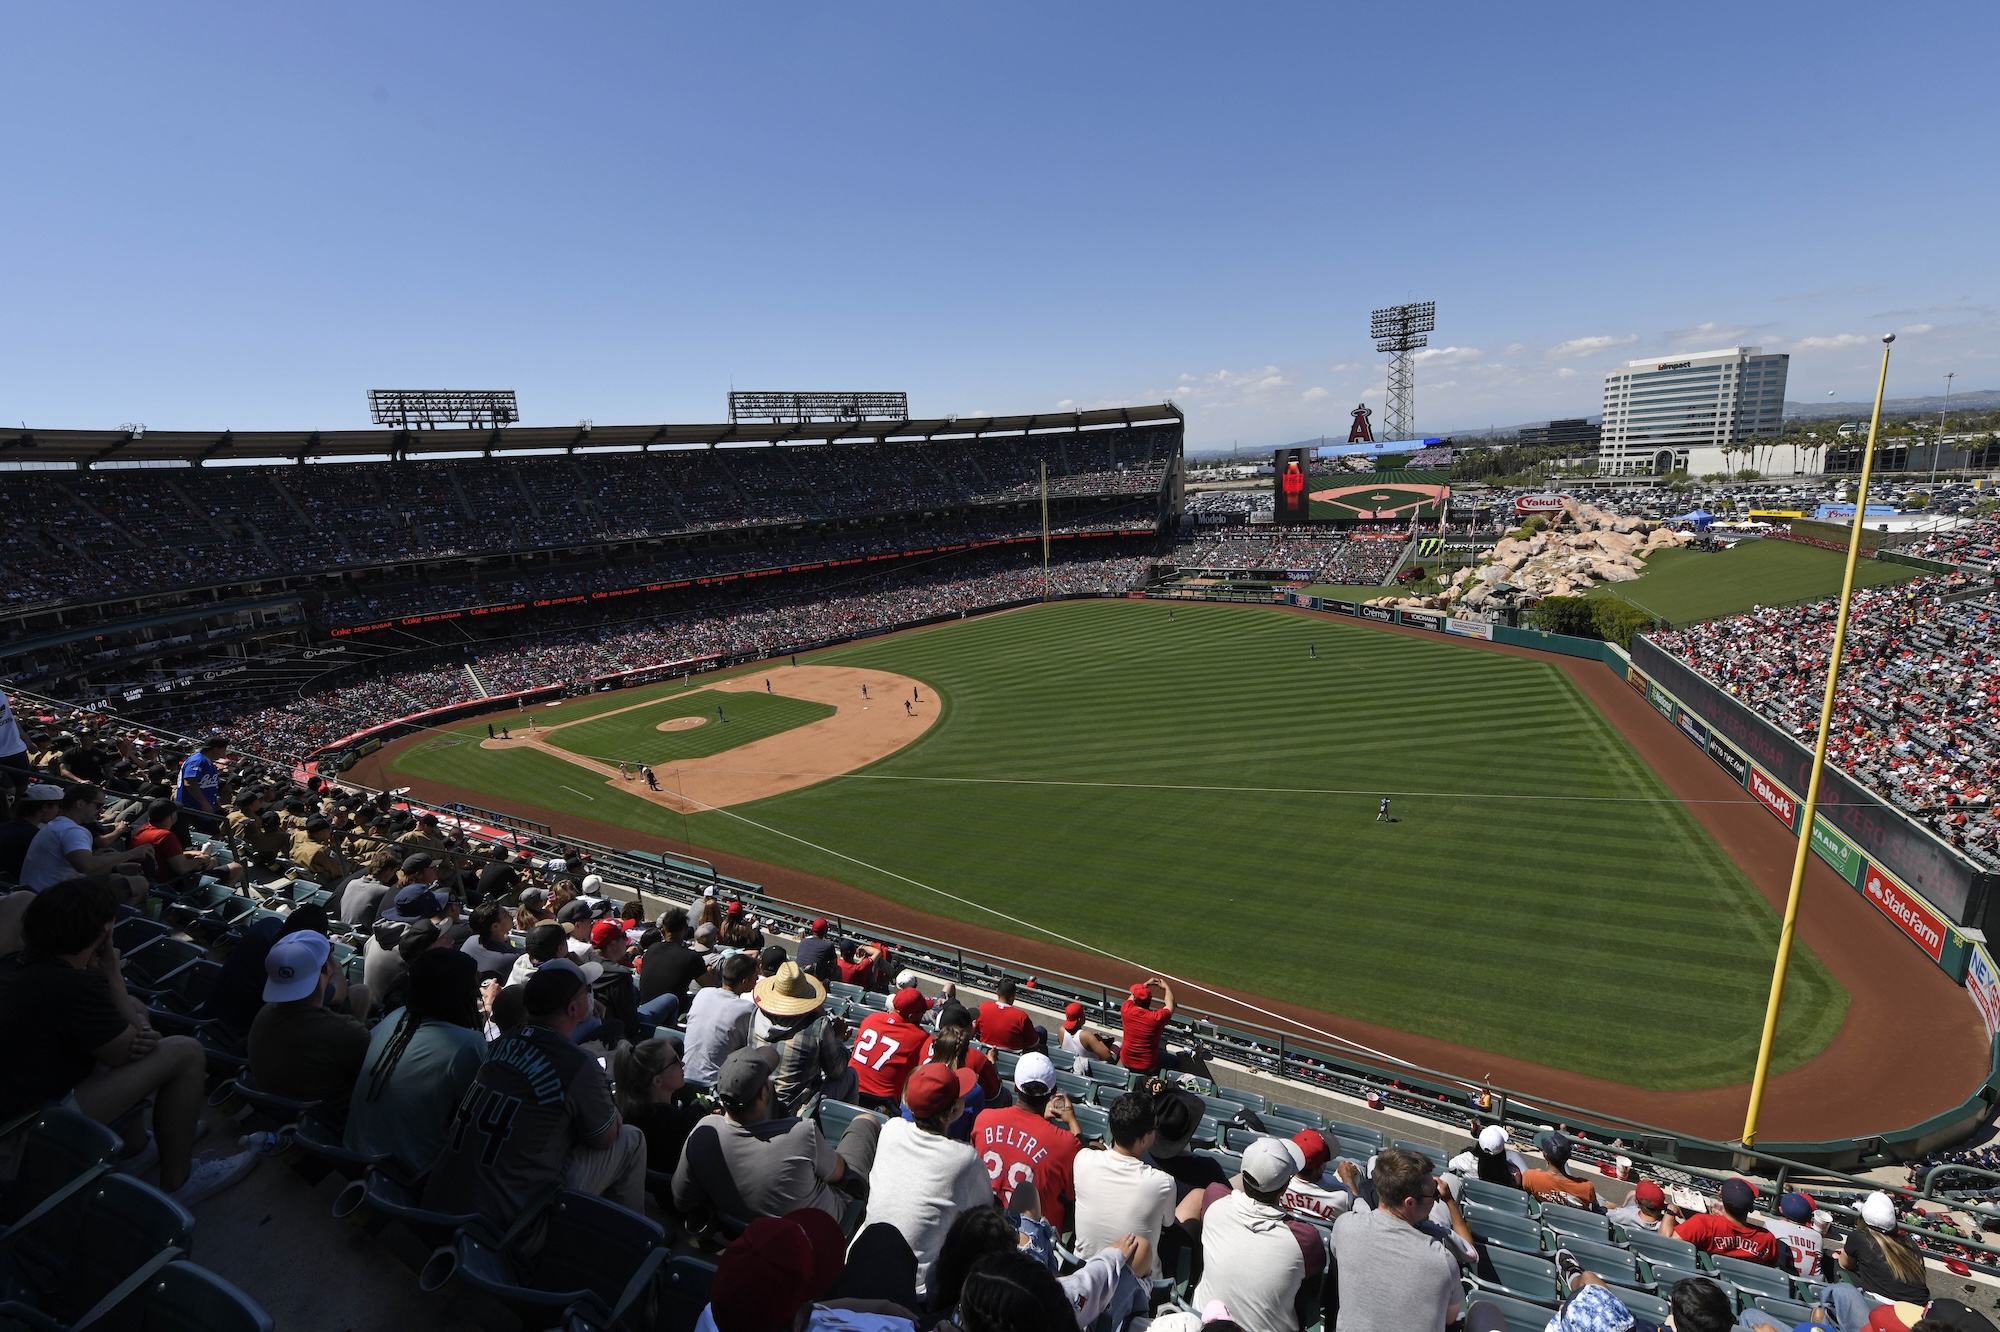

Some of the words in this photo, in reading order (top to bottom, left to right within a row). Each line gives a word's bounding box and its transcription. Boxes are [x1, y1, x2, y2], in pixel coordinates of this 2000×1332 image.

[1525, 499, 1563, 507] Yakult
[1199, 514, 1227, 524] Modelo
[371, 622, 392, 630] SUGAR
[1411, 614, 1437, 623] YOKOHAMA
[314, 645, 346, 656] LEXUS
[215, 665, 247, 677] LEXUS
[1723, 712, 1747, 740] ZERO
[1748, 731, 1784, 767] SUGAR
[1710, 740, 1724, 757] NITTO
[1723, 751, 1745, 777] TIRE.COM
[1753, 773, 1792, 819] Yakult
[1799, 761, 1840, 814] Cke
[1844, 805, 1886, 848] ZERO
[1812, 826, 1824, 842] VA
[1822, 836, 1839, 855] AIR
[1882, 888, 1940, 949] StateFarm
[1953, 934, 1964, 949] 365
[1970, 951, 2000, 1030] NEXGE
[853, 1028, 901, 1071] 27
[452, 1079, 523, 1169] 44
[985, 1125, 1048, 1164] BELTRE
[1714, 1235, 1770, 1259] PUJOLS
[1788, 1234, 1816, 1251] TROUT
